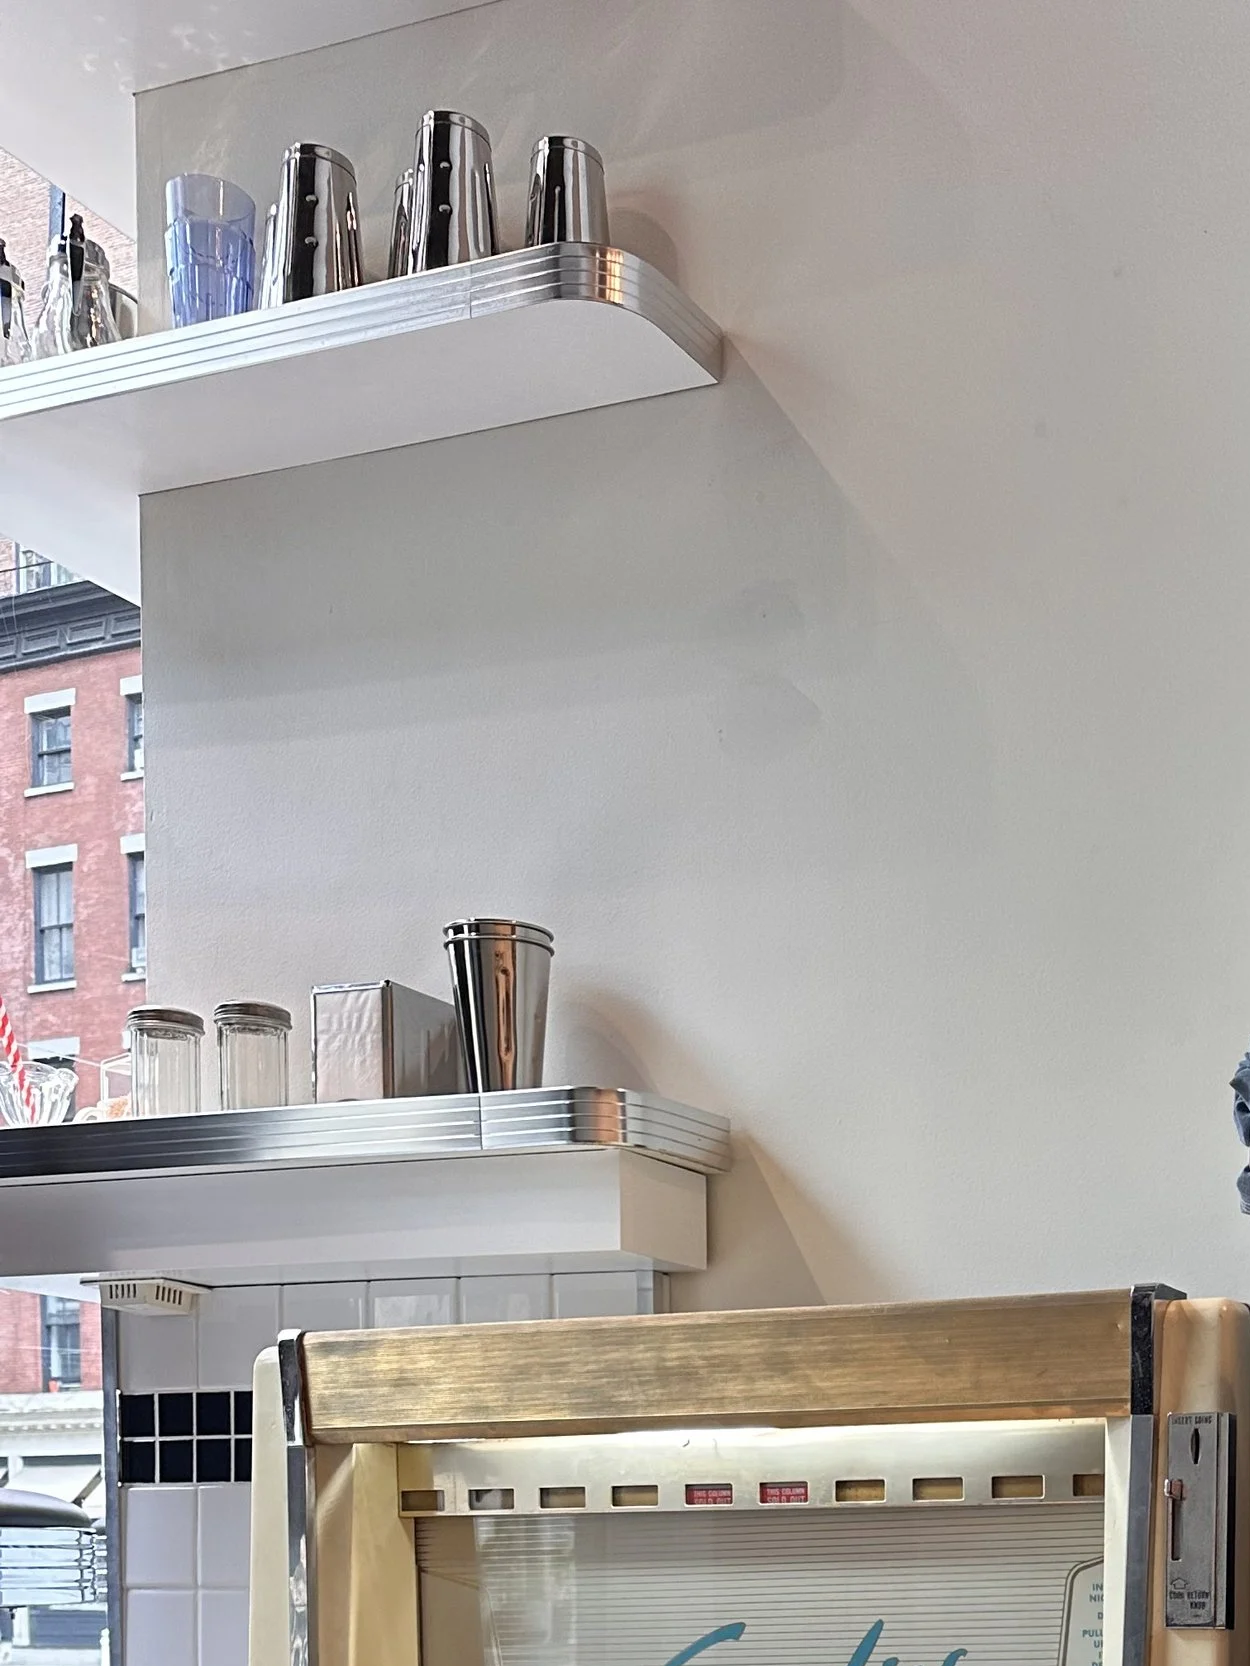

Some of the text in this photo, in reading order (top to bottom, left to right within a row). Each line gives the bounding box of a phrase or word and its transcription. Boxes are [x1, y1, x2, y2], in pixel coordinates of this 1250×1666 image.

[693, 1490, 707, 1498] THIS
[766, 1487, 806, 1496] THIS COLUMN
[766, 1496, 806, 1504] SOLD OUT
